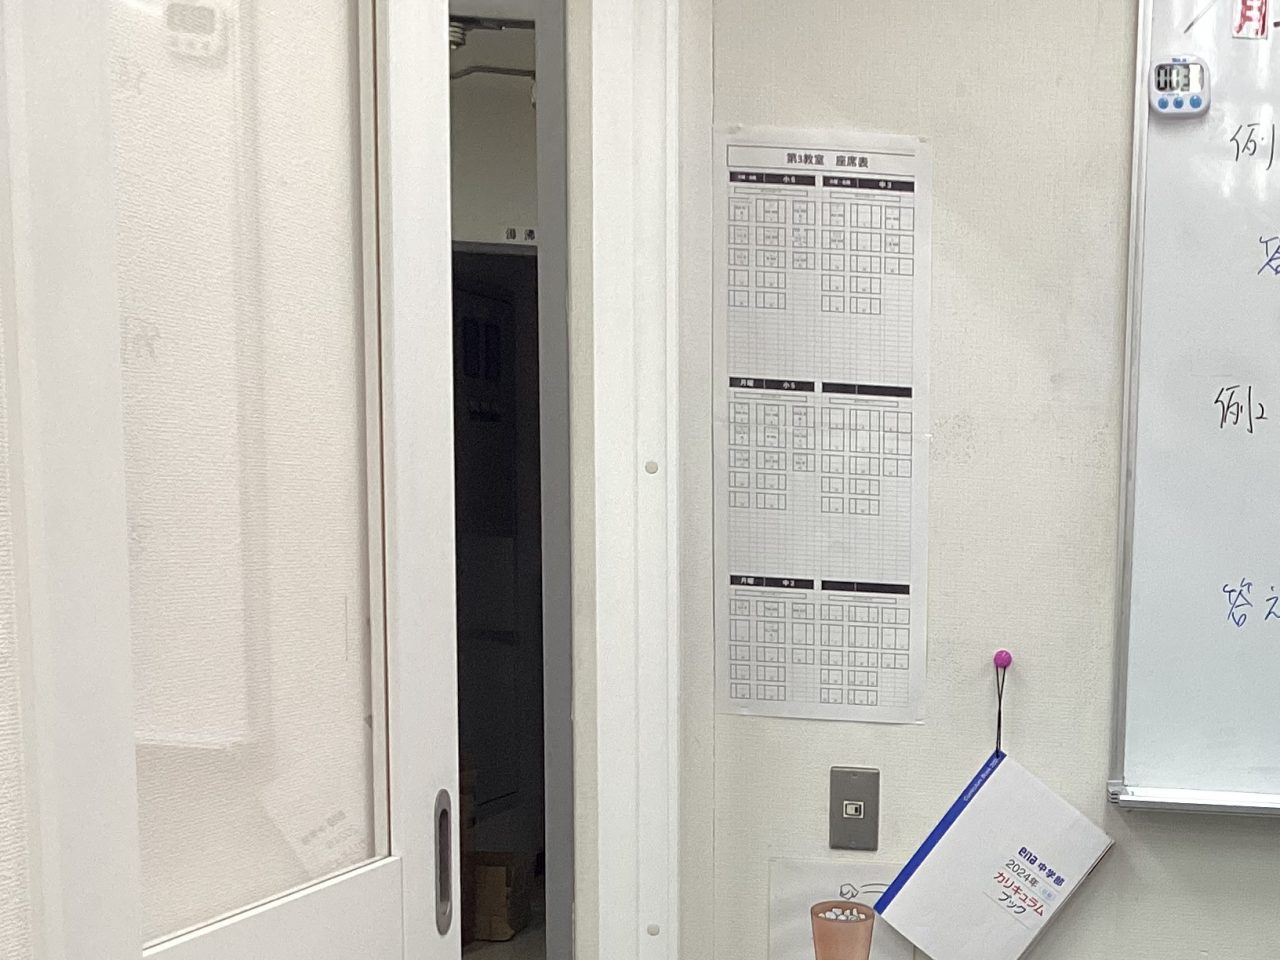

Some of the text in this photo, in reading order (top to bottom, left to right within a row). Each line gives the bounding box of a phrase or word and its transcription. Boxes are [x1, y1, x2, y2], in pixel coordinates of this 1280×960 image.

[836, 154, 869, 168] 座席表
[1005, 858, 1040, 888] 2024年
[1018, 846, 1066, 887] ena 中学部
[993, 871, 1044, 917] カリキュラム
[998, 890, 1027, 914] ブック
